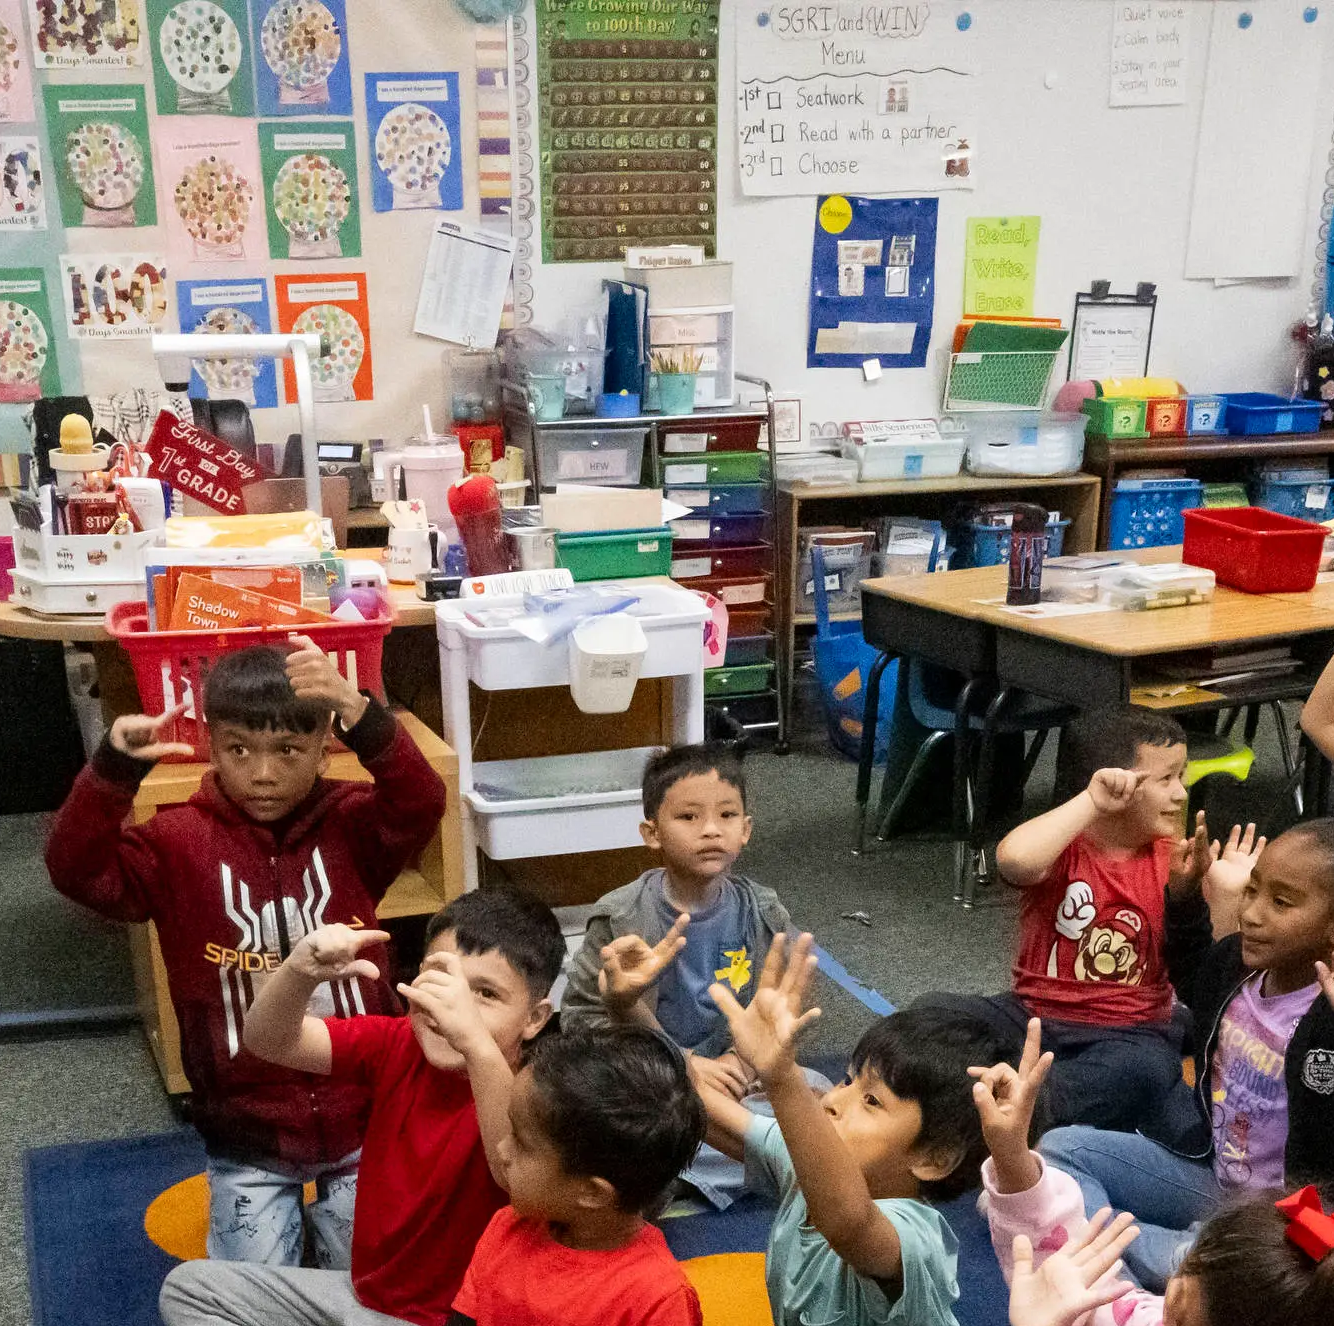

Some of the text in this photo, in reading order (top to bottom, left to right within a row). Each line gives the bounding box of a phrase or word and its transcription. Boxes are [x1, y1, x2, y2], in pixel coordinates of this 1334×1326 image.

[588, 0, 648, 14] Growing
[652, 0, 677, 13] Our
[682, 0, 709, 16] Way
[1123, 3, 1184, 21] Quiet voice
[587, 16, 676, 34] to 100th Day!
[779, 8, 918, 33] SGRI and WIN
[1124, 26, 1179, 46] Calm body
[56, 55, 124, 66] Days Smarter!
[699, 49, 707, 57] 10
[822, 41, 866, 65] Menu
[700, 70, 710, 78] 20
[1121, 59, 1143, 75] Stay
[796, 85, 865, 108] Seatwork
[800, 121, 838, 143] Read
[849, 120, 874, 141] with
[882, 129, 891, 140] a
[902, 115, 957, 146] partner
[700, 161, 709, 169] 60
[798, 153, 859, 174] Choose
[620, 203, 708, 212] 75 80
[975, 223, 1031, 247] Read,
[973, 257, 1029, 280] Write,
[975, 292, 1026, 313] Erase
[88, 326, 152, 338] Days Smarter!
[158, 446, 187, 473] 1st
[171, 420, 255, 479] First Day
[177, 469, 241, 510] GRADE
[189, 595, 240, 620] Shadow
[187, 610, 219, 630] Town
[204, 943, 282, 973] SPIDE
